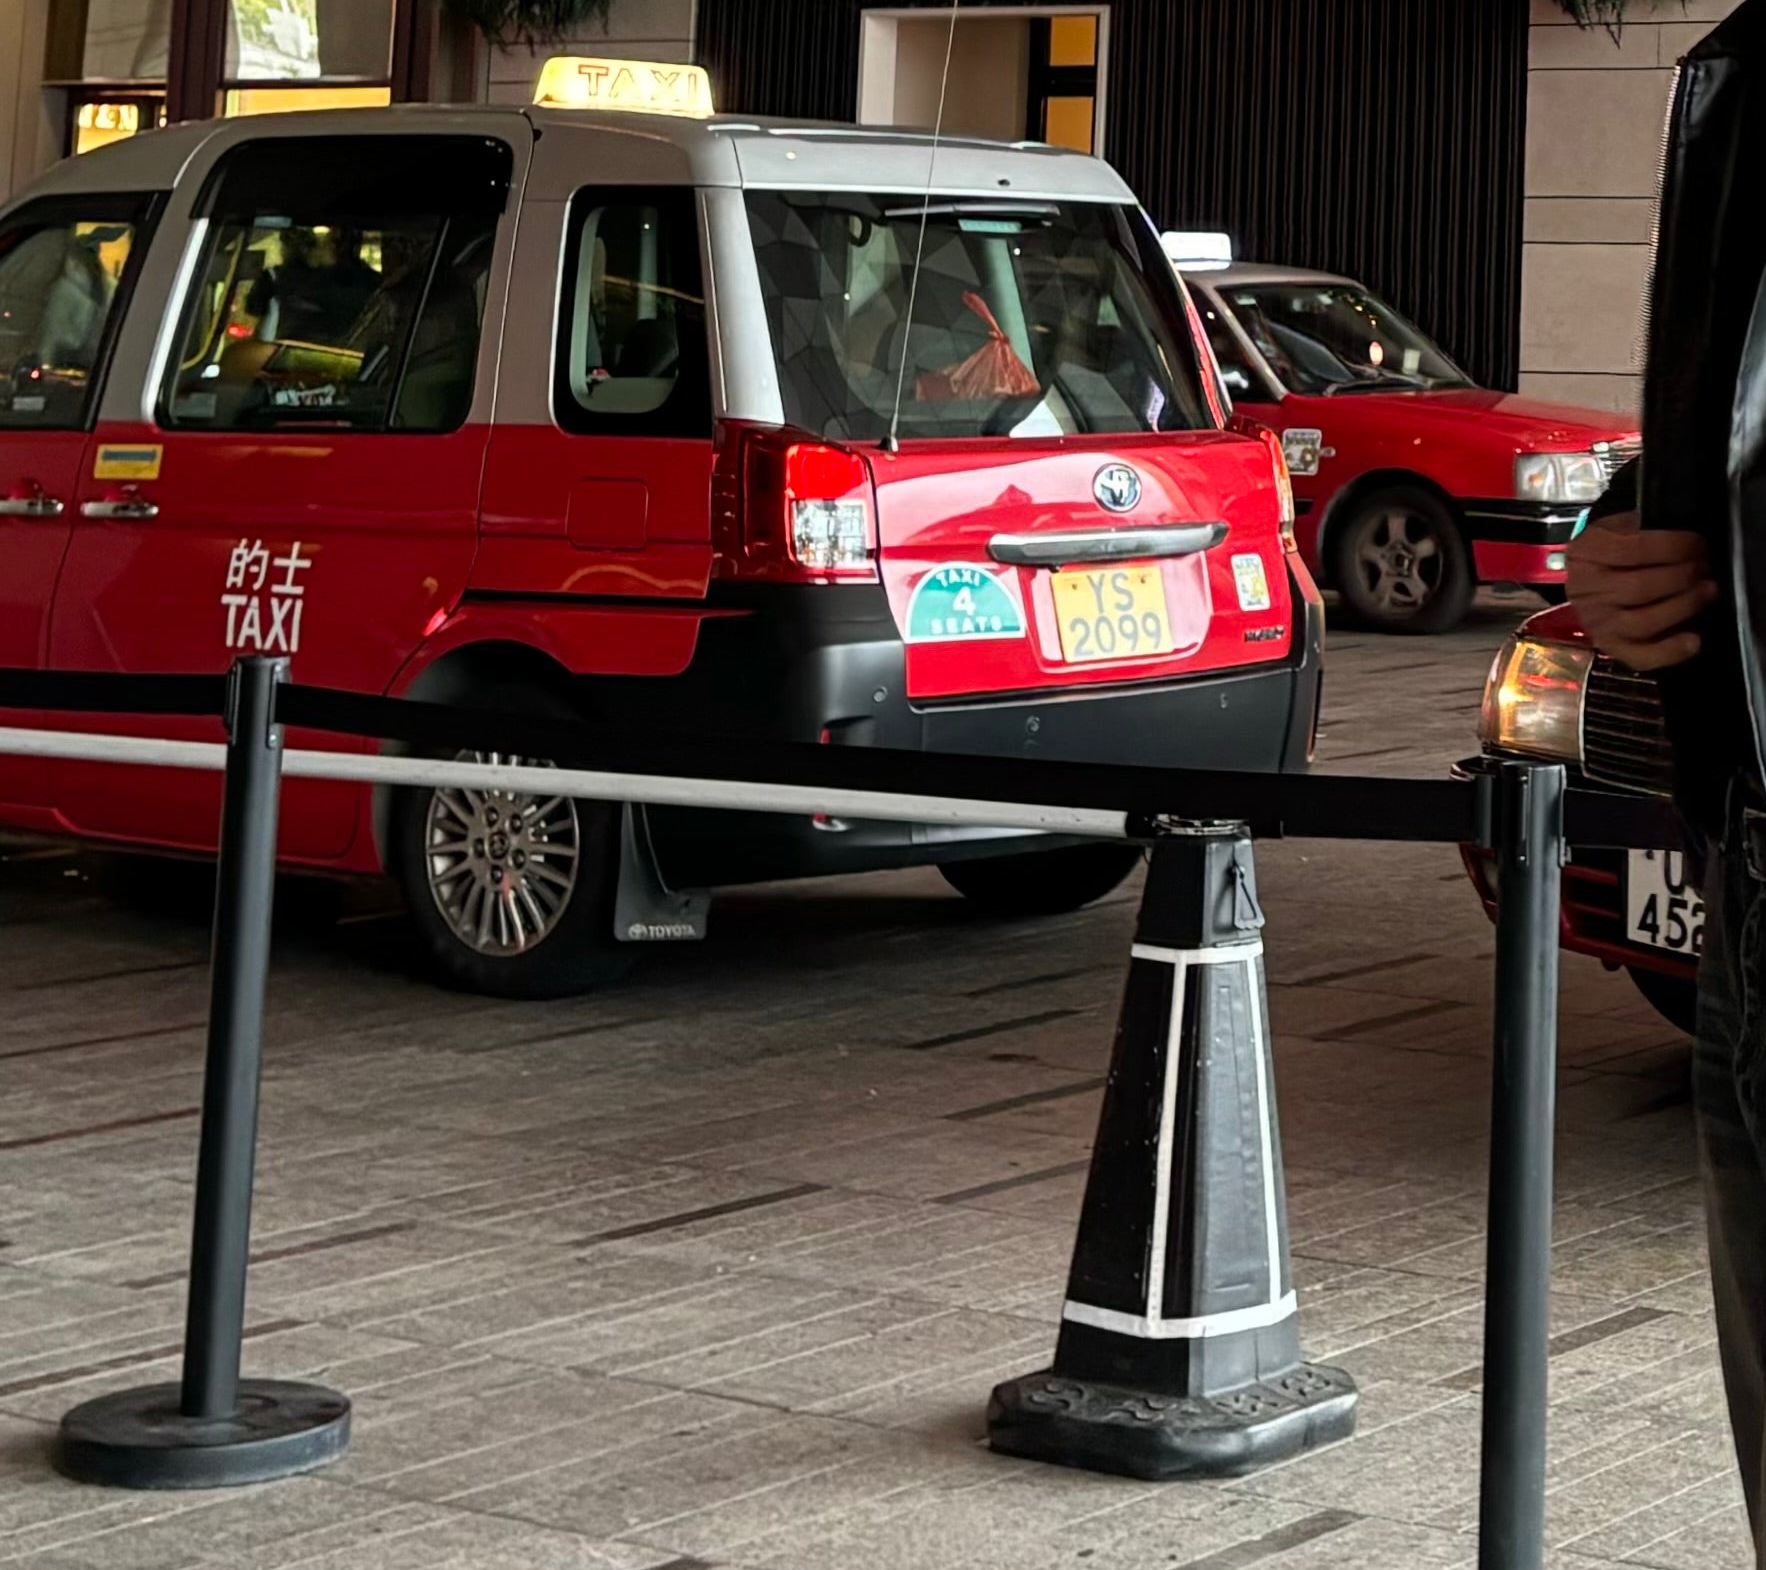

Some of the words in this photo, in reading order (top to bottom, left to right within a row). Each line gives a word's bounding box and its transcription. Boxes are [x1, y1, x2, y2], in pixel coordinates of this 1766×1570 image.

[226, 537, 312, 595] 的士
[935, 568, 981, 588] TAXI
[952, 586, 976, 615] 4
[1086, 572, 1135, 614] YS
[221, 594, 304, 653] TAXI
[930, 616, 1003, 636] SEATS
[1069, 612, 1162, 659] 2099
[648, 925, 697, 939] TOYOTA
